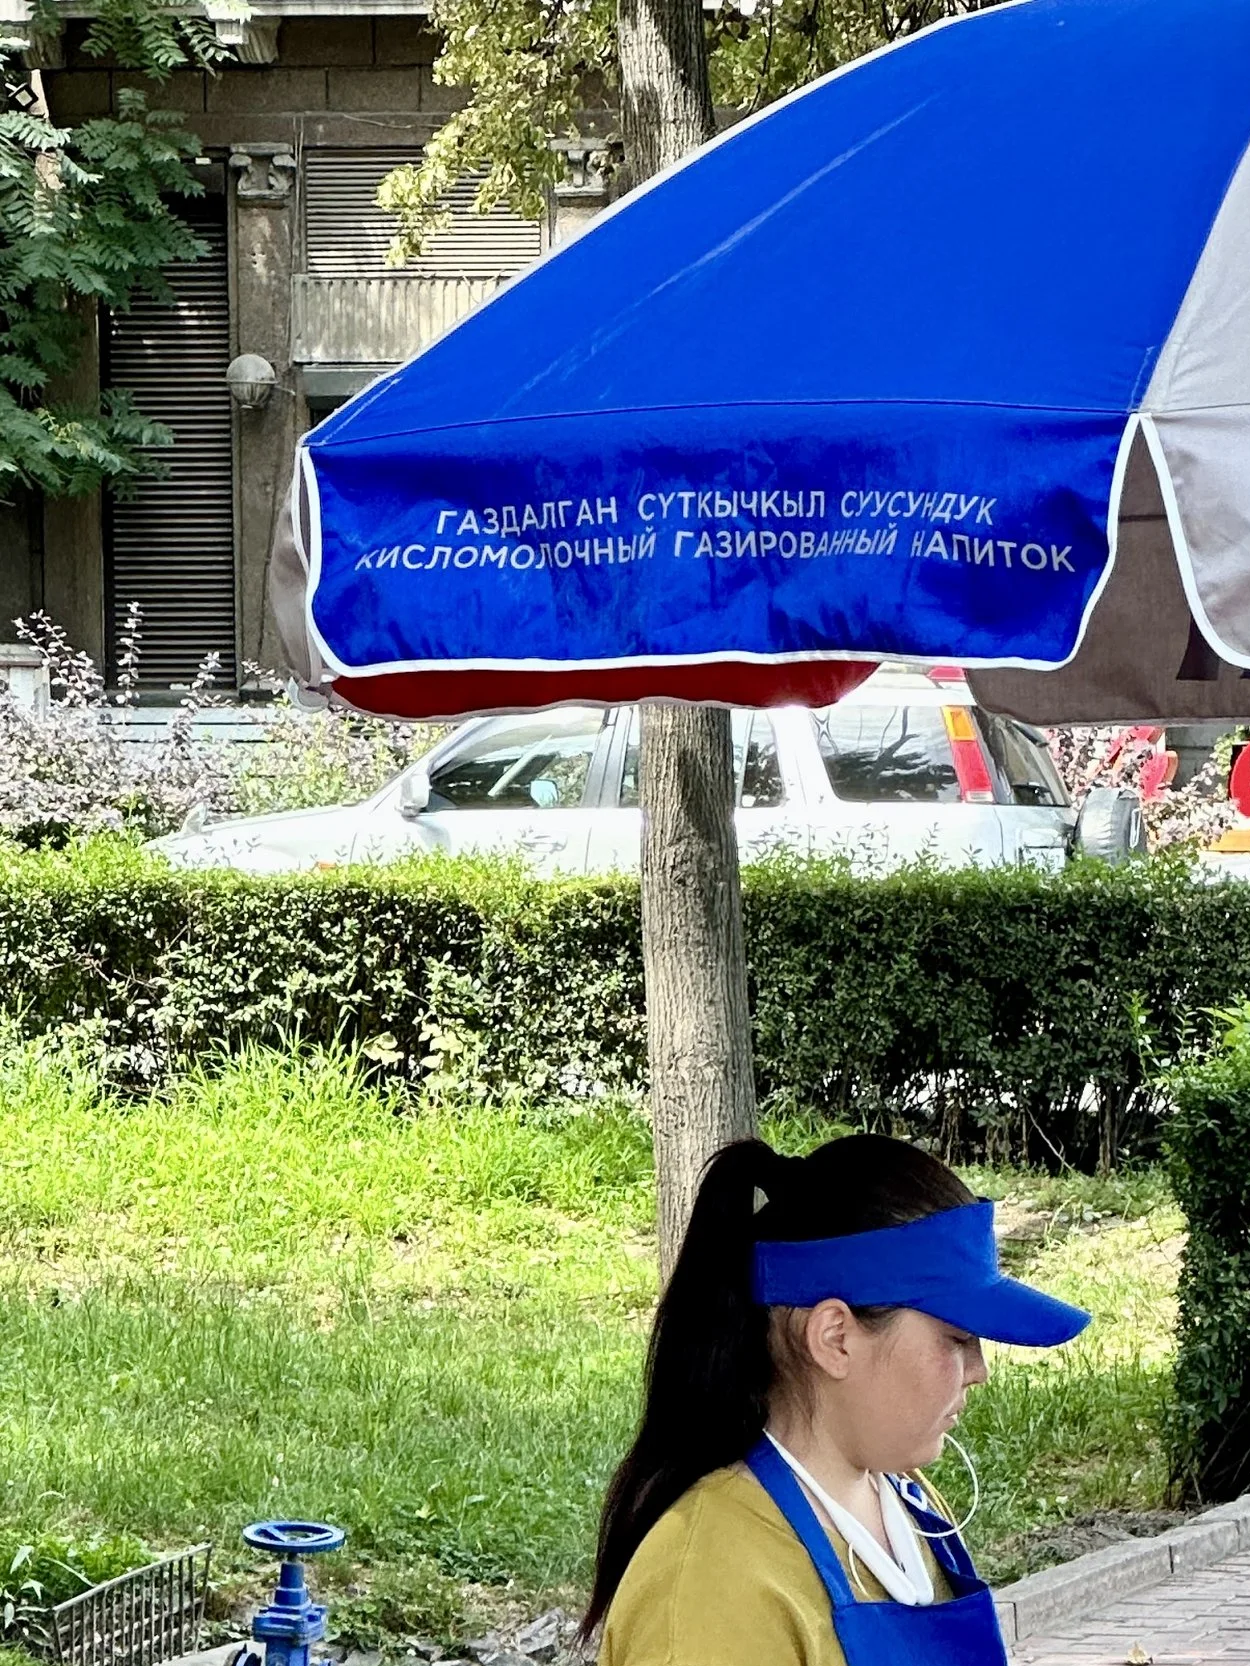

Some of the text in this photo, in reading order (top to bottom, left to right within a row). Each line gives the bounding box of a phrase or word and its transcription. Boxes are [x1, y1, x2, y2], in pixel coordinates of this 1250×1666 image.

[435, 495, 618, 538] ГАЗДАЛГАН
[840, 490, 998, 526] СУУСУНДУК
[353, 522, 1076, 573] КИСЛОМОЛОЧНЫЙ ГАЗИРОВАННЫЙ НАПИТОК
